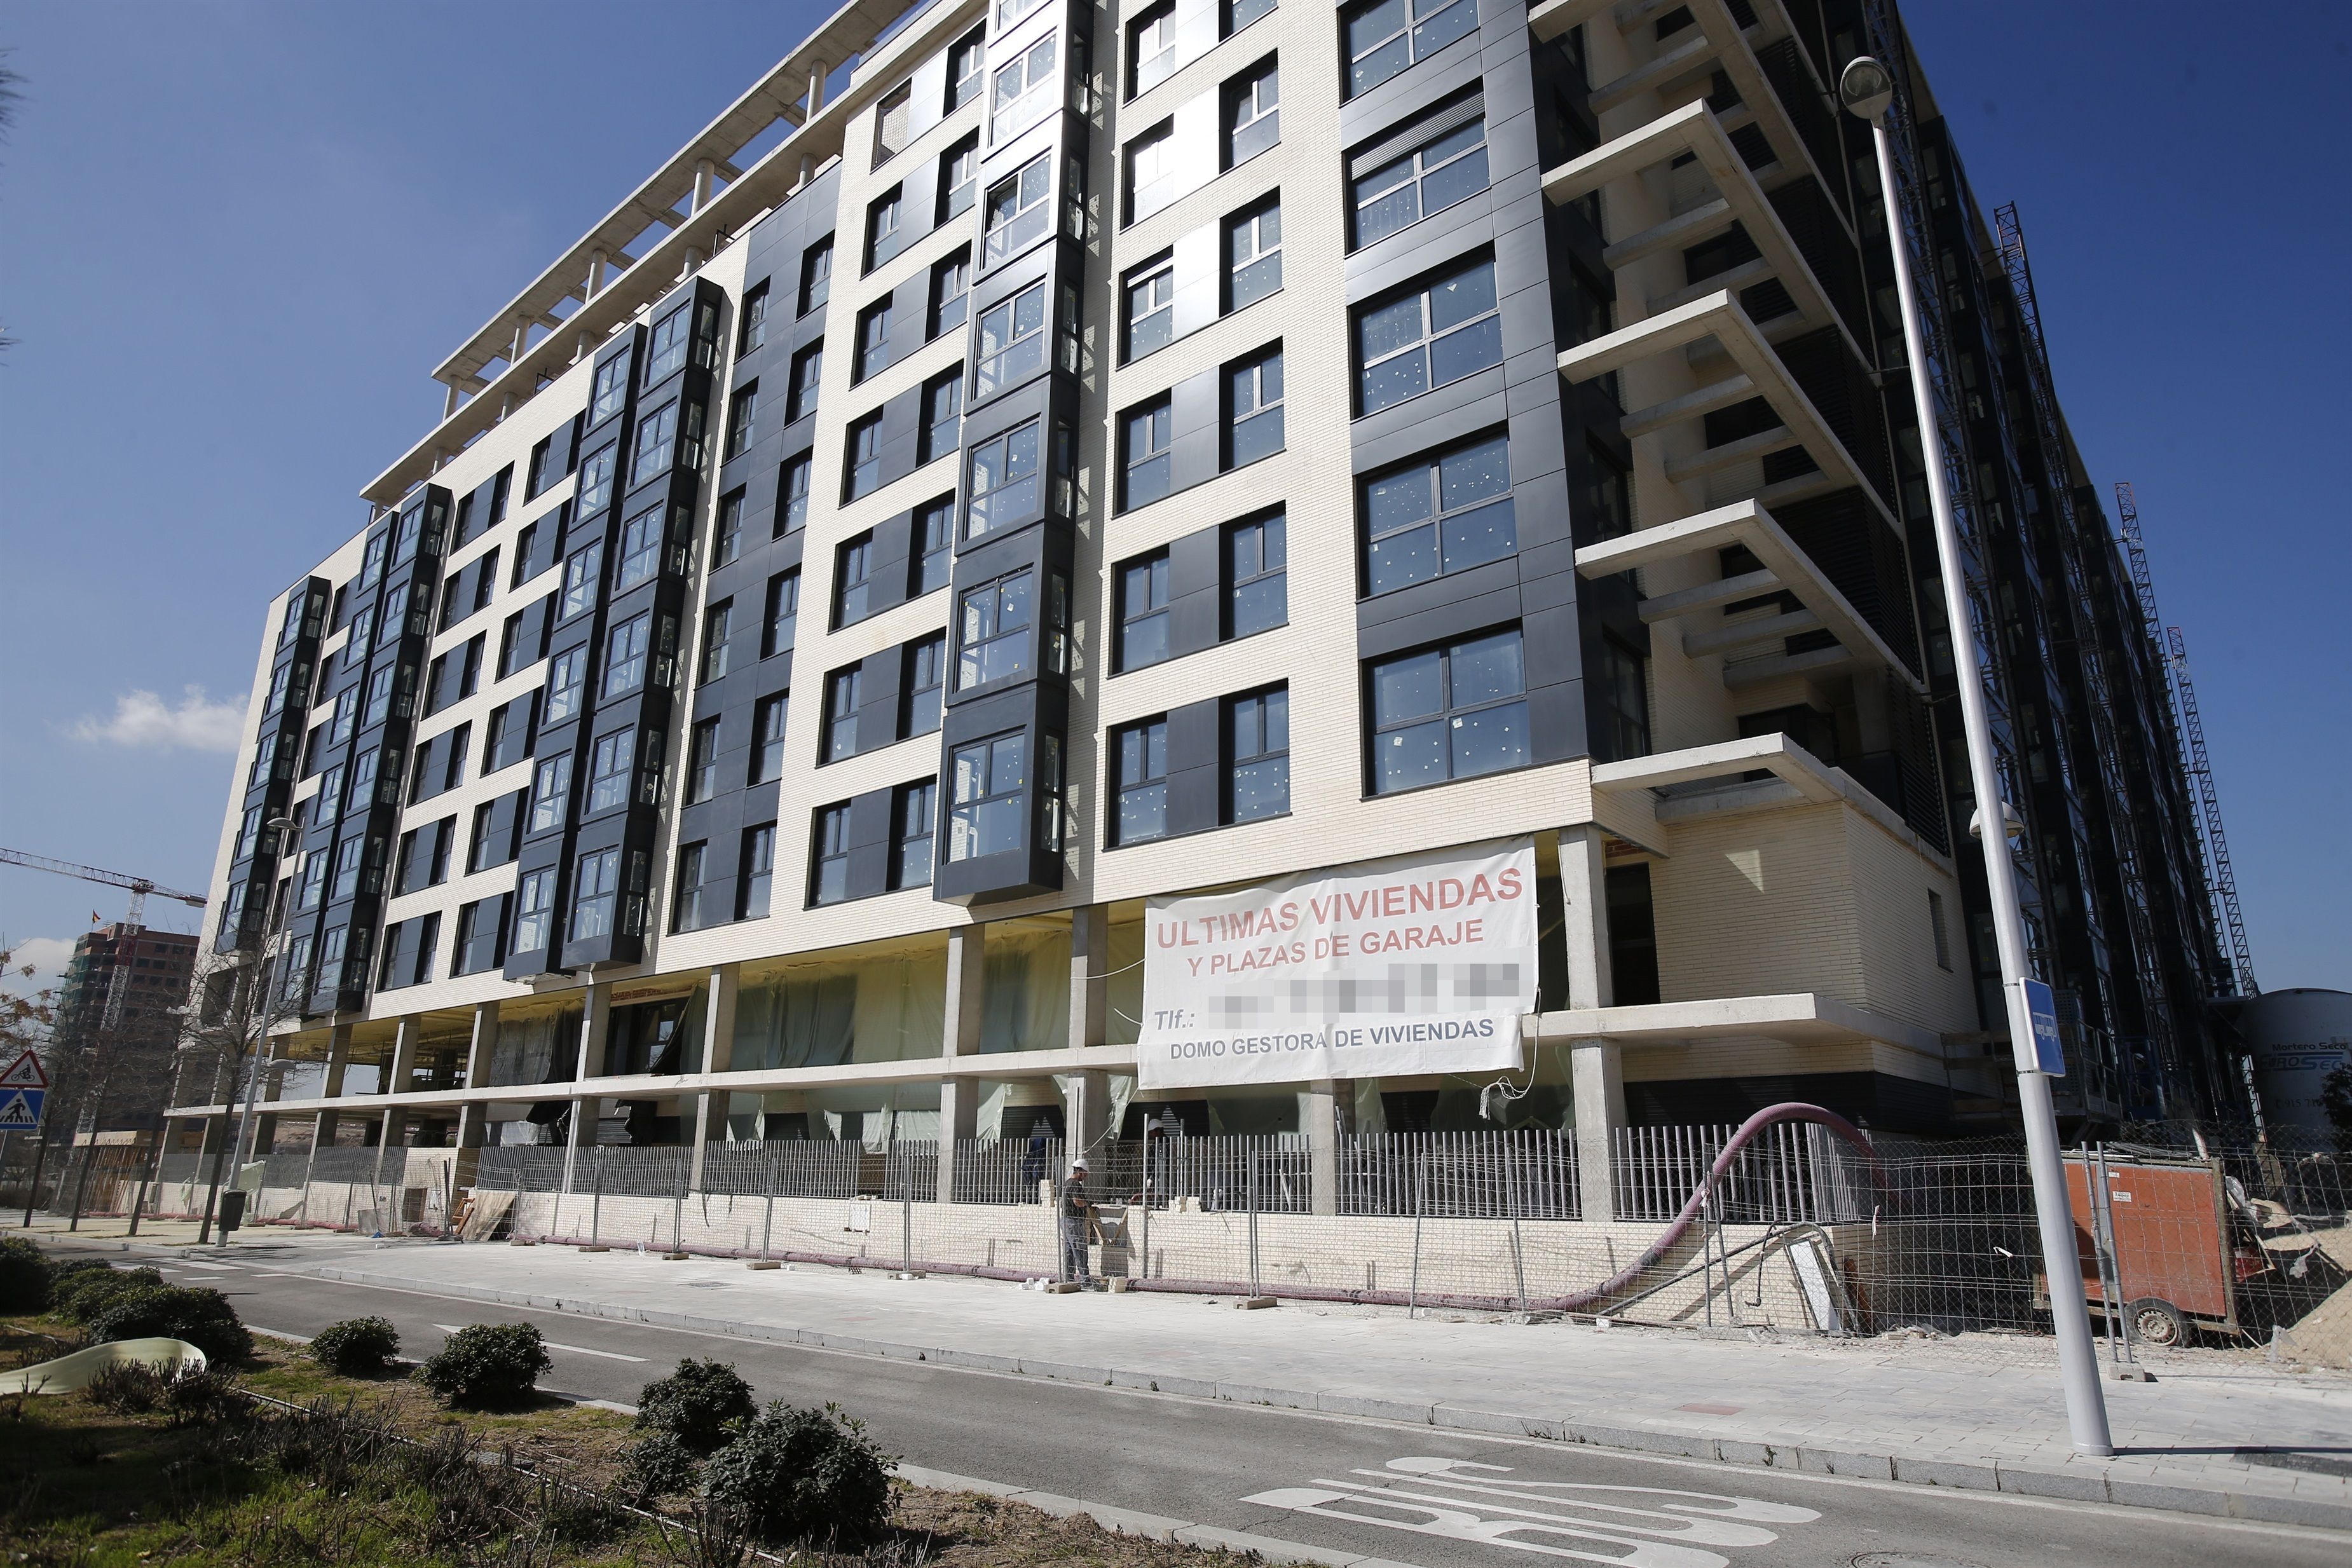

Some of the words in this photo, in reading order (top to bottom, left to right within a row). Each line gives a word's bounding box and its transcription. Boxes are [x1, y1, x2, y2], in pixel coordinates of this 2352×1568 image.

[1158, 902, 1299, 949] ULTIMAS
[1309, 868, 1523, 925] VIVIENDAS
[1187, 957, 1204, 977] Y
[1210, 941, 1306, 975] PLAZAS
[1314, 934, 1350, 960] DE
[1359, 918, 1484, 955] GARAJE
[1154, 1009, 1196, 1030] Tlf.:
[1170, 1039, 1226, 1060] DOMO
[1231, 1032, 1327, 1056] GESTORA
[1334, 1028, 1364, 1047] DE
[1369, 1018, 1494, 1044] VIVIENDAS
[2272, 1042, 2316, 1051] Mortero
[1237, 1456, 1822, 1568] BUS
